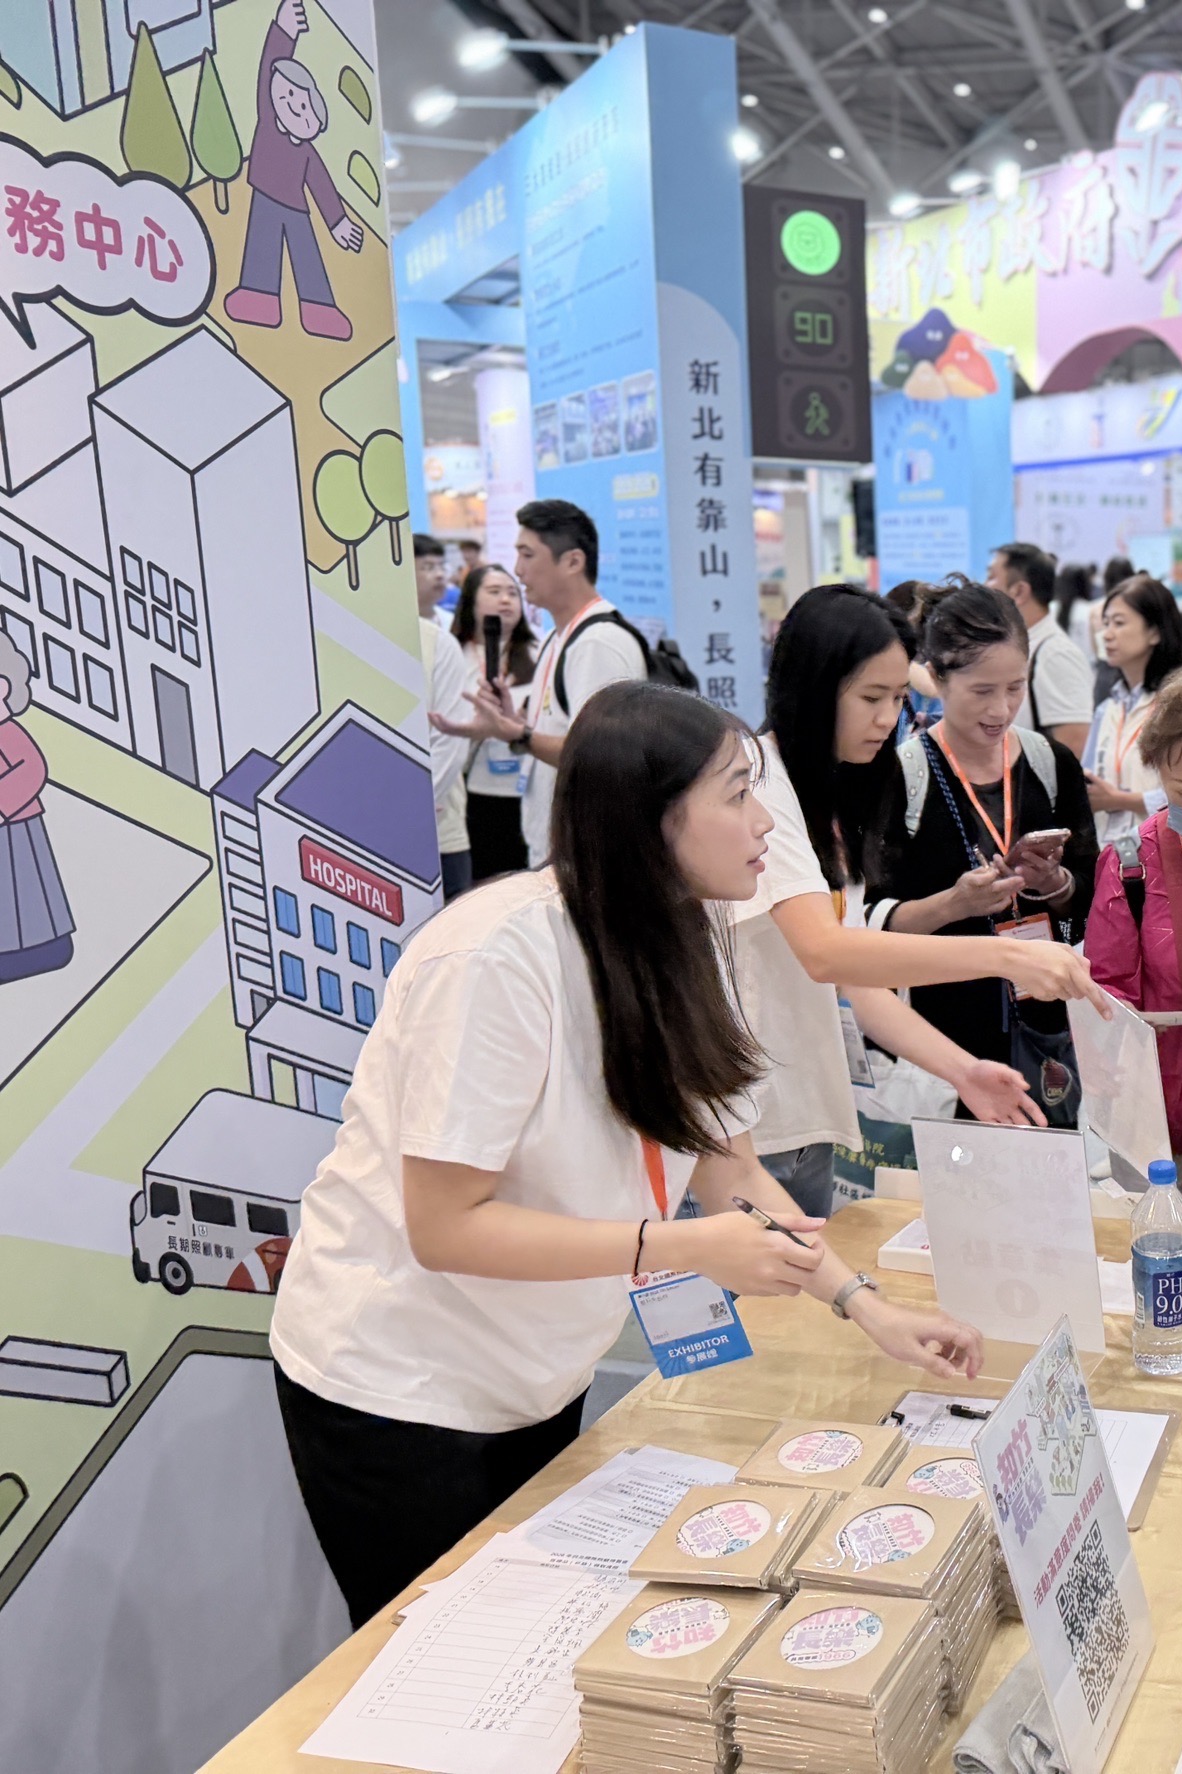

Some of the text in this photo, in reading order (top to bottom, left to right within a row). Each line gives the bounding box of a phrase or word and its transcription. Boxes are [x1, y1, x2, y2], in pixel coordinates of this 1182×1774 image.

[4, 184, 184, 284] 務中心
[794, 311, 833, 345] 90
[308, 853, 393, 917] HOSPITAL
[1158, 1277, 1182, 1295] PH
[1156, 1294, 1182, 1315] 9.0
[668, 1334, 730, 1358] EXHIBITOR
